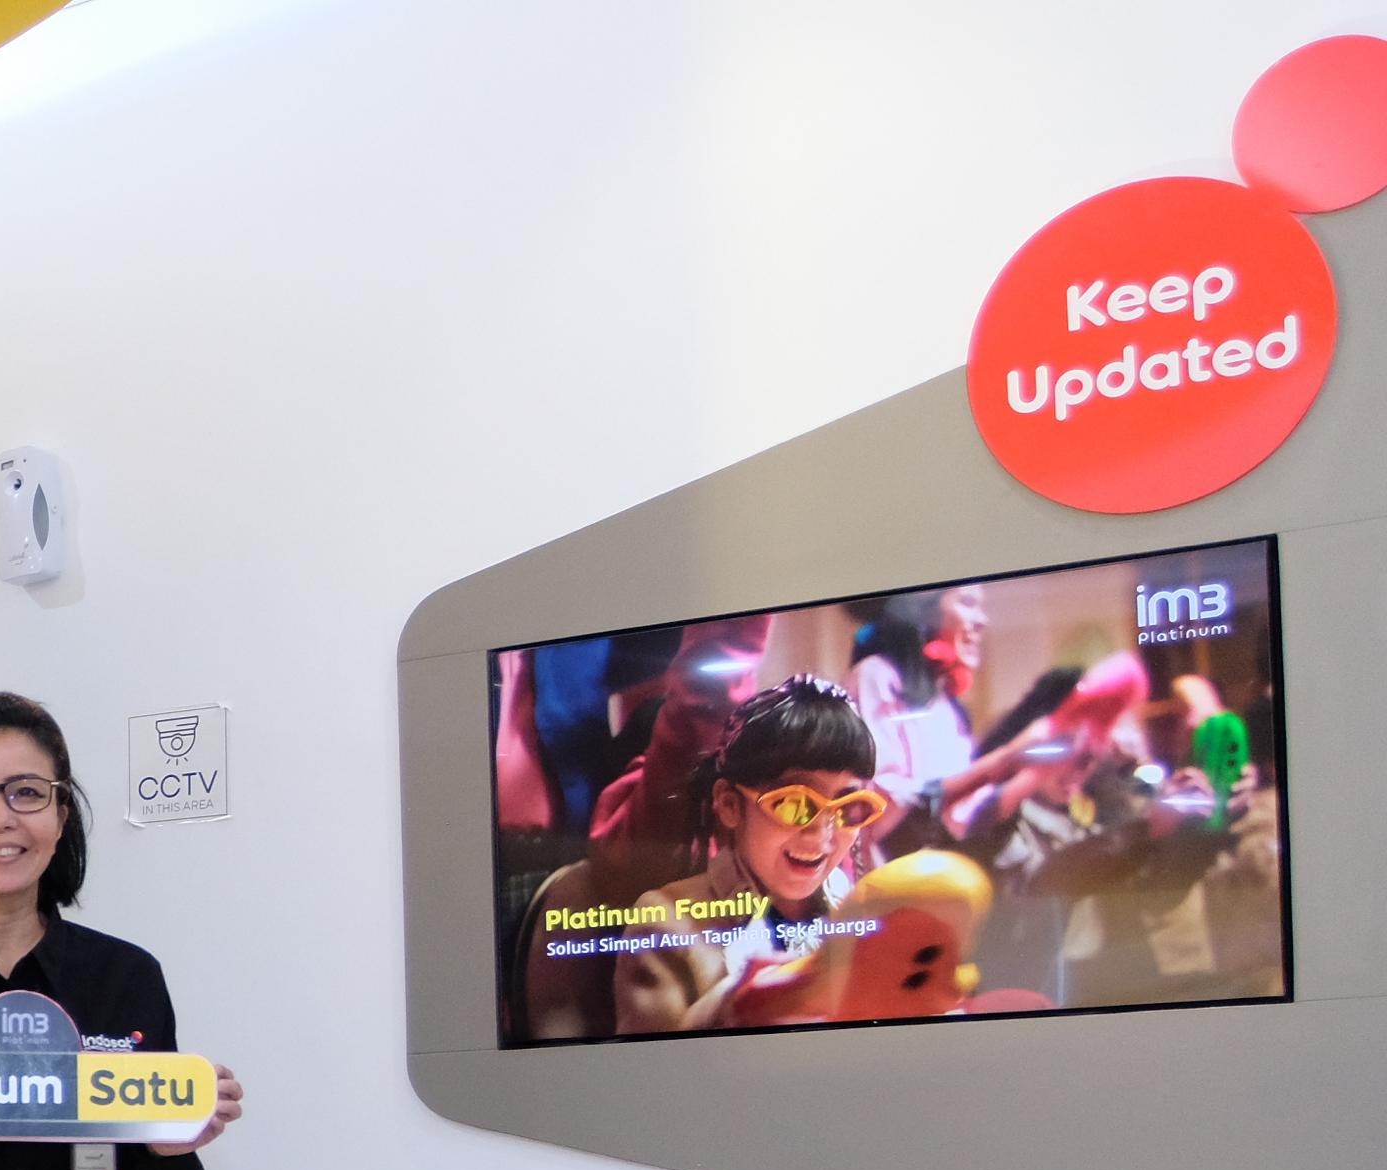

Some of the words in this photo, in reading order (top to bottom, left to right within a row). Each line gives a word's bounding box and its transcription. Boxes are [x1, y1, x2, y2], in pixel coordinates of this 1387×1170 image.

[1066, 266, 1235, 332] Keep
[1007, 314, 1297, 422] Updated
[1136, 584, 1227, 627] im3
[138, 770, 218, 800] CCTV
[142, 805, 154, 815] IN
[156, 802, 181, 814] THIS
[183, 799, 214, 811] AREA
[545, 904, 667, 931] Platinum
[676, 891, 769, 920] Family
[546, 940, 595, 957] Solusi
[599, 935, 655, 955] Simpel
[660, 931, 696, 948] Atur
[702, 925, 771, 946] Tagihan
[776, 917, 877, 940] Sekeluarga
[2, 1007, 49, 1034] im3
[90, 1069, 195, 1107] Satu
